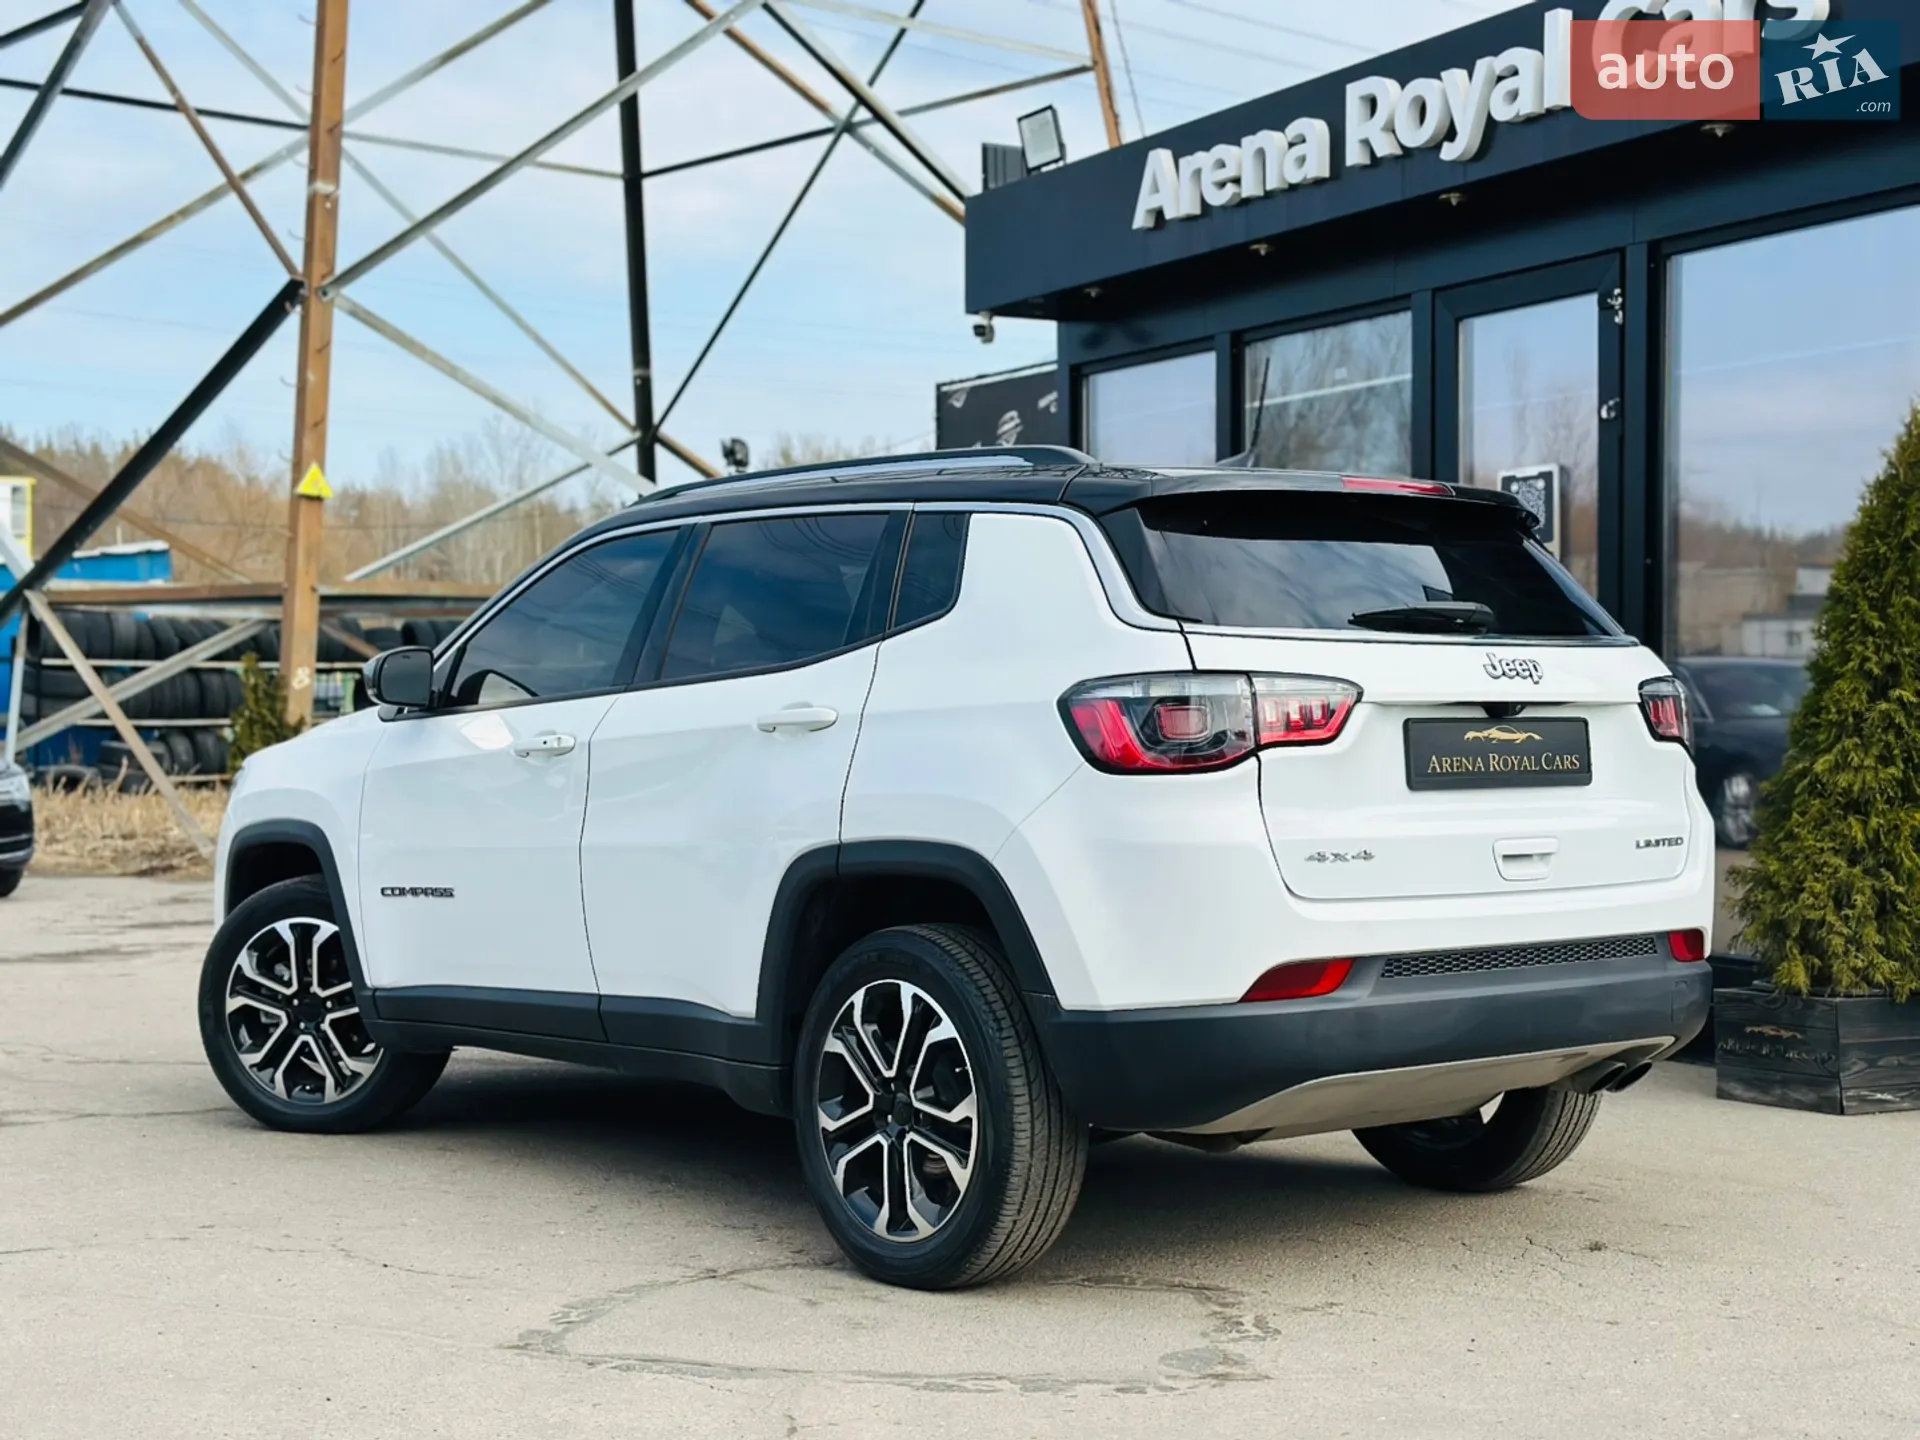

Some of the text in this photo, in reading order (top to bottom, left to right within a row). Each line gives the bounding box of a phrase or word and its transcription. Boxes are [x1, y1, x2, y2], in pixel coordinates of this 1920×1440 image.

[1131, 117, 1331, 231] Arena
[1345, 8, 1573, 167] Royal
[1482, 652, 1544, 685] Jeep
[1635, 836, 1684, 850] LIMITED
[380, 886, 455, 898] COMPASS
